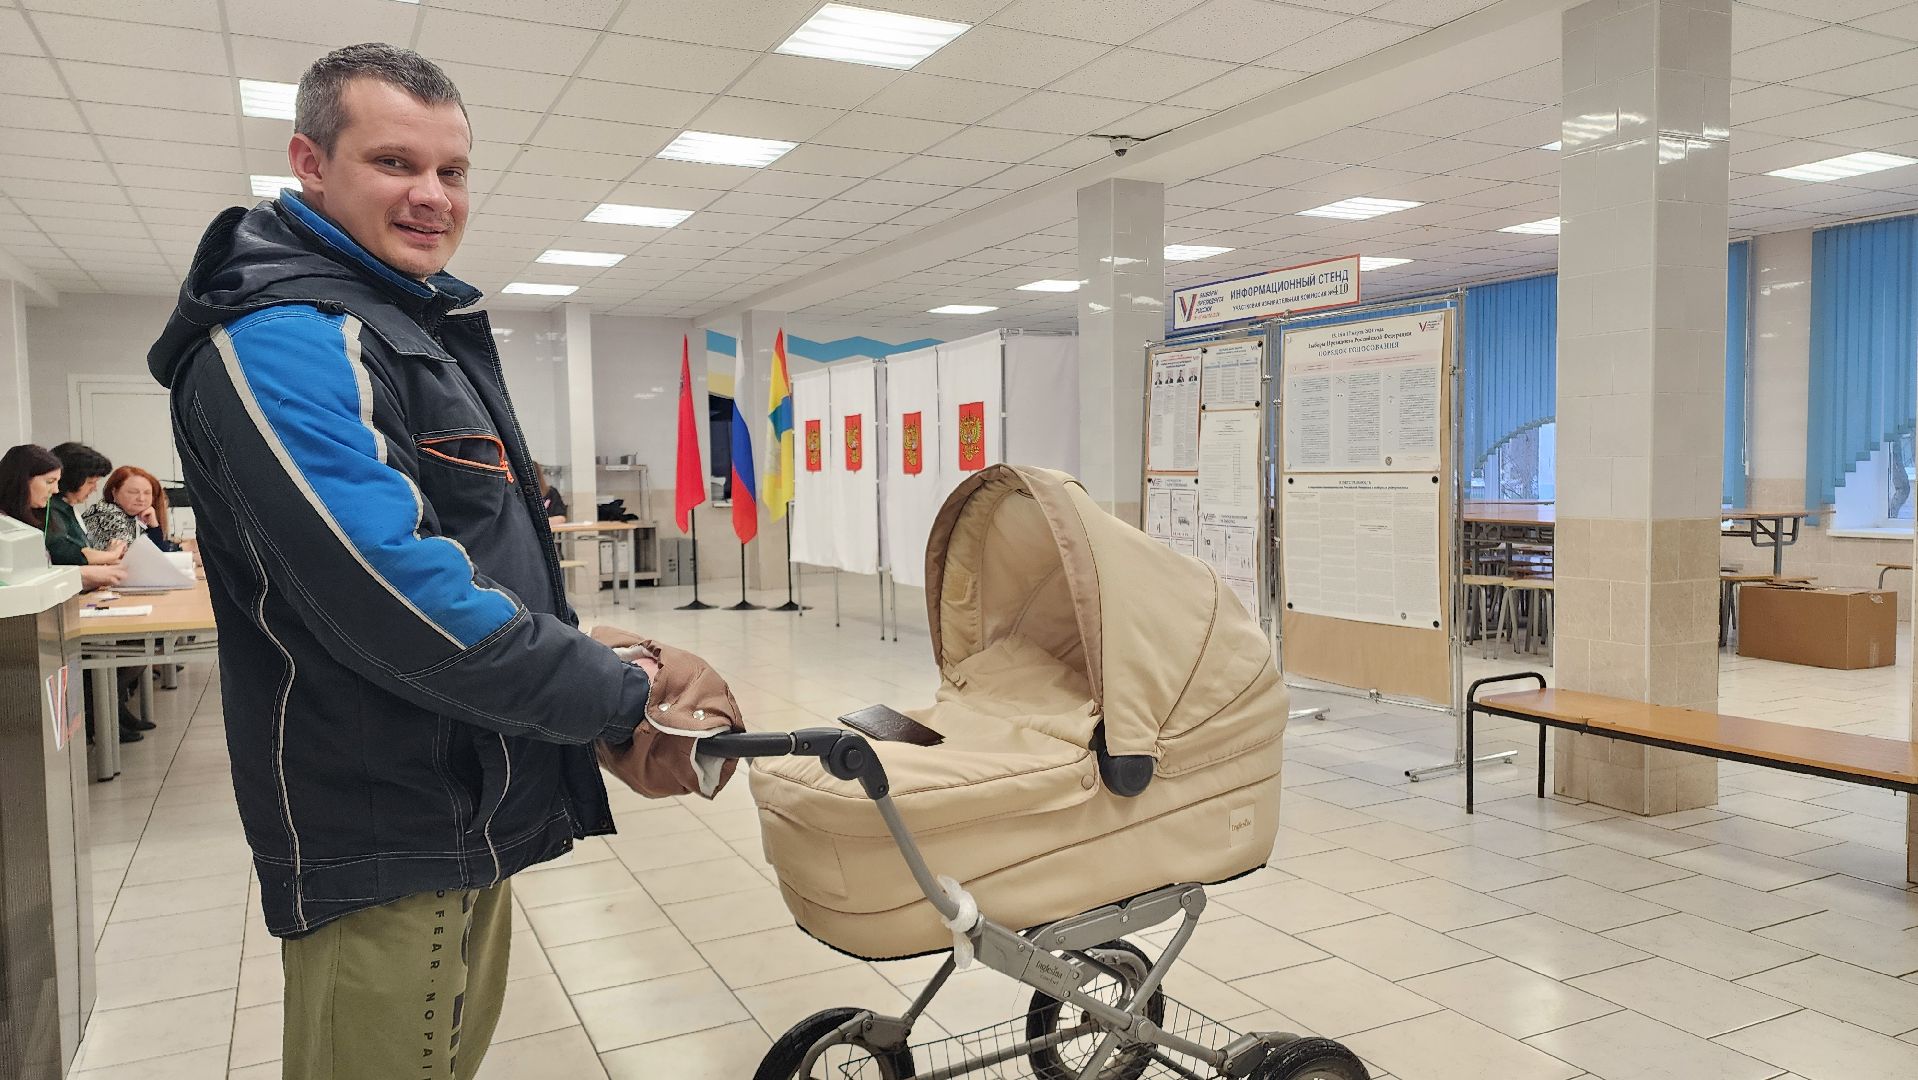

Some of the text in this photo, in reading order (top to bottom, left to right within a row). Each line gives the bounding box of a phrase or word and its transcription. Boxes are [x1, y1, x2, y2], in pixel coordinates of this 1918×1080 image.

[1230, 269, 1349, 300] ИНФОРМАЦИОННЫЙ СТЕНД
[1233, 301, 1261, 311] УЧАСТКОВАЯ
[1262, 295, 1300, 307] ИЗБИРАТЕЛЬНАЯ
[1301, 290, 1327, 301] КОМИССИЯ
[422, 1031, 434, 1080] PAI
